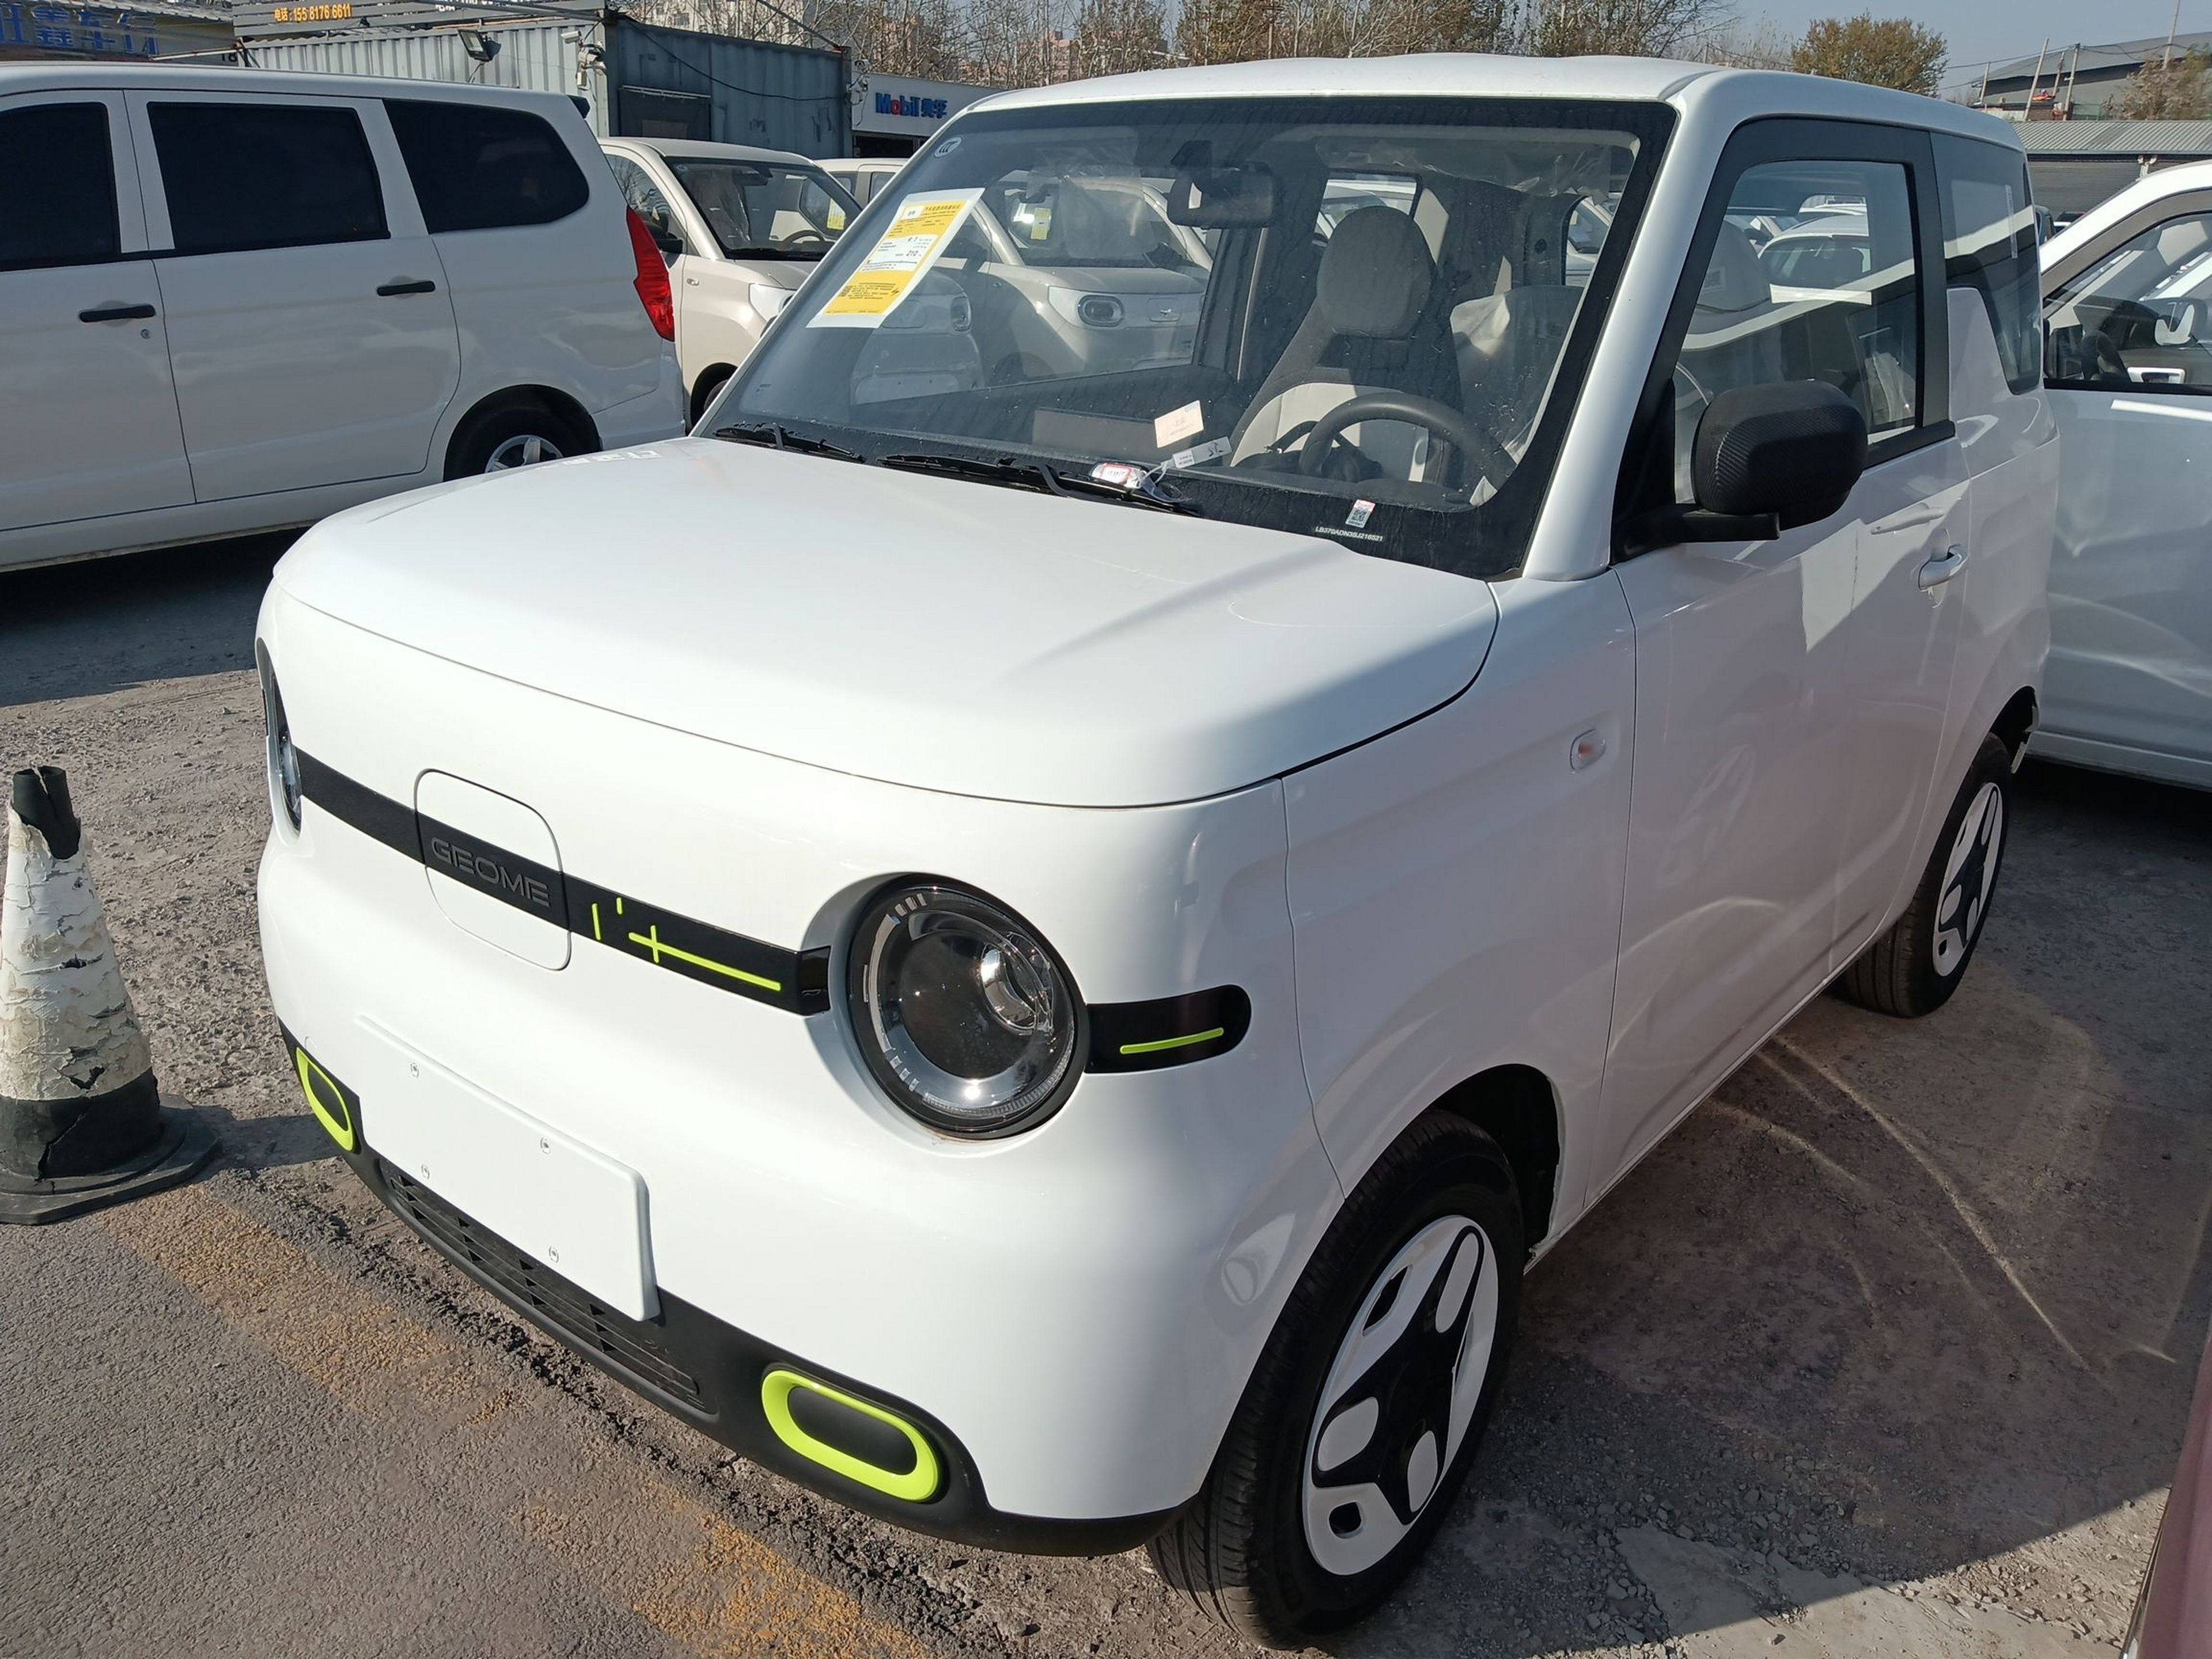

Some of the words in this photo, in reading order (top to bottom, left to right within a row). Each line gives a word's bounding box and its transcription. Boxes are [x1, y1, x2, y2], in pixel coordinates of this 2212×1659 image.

[293, 7, 307, 21] 155
[309, 5, 329, 20] 8176
[332, 3, 351, 19] 6611
[876, 92, 920, 117] Mobil
[922, 98, 948, 119] 美孚
[431, 837, 551, 907] GEOME
